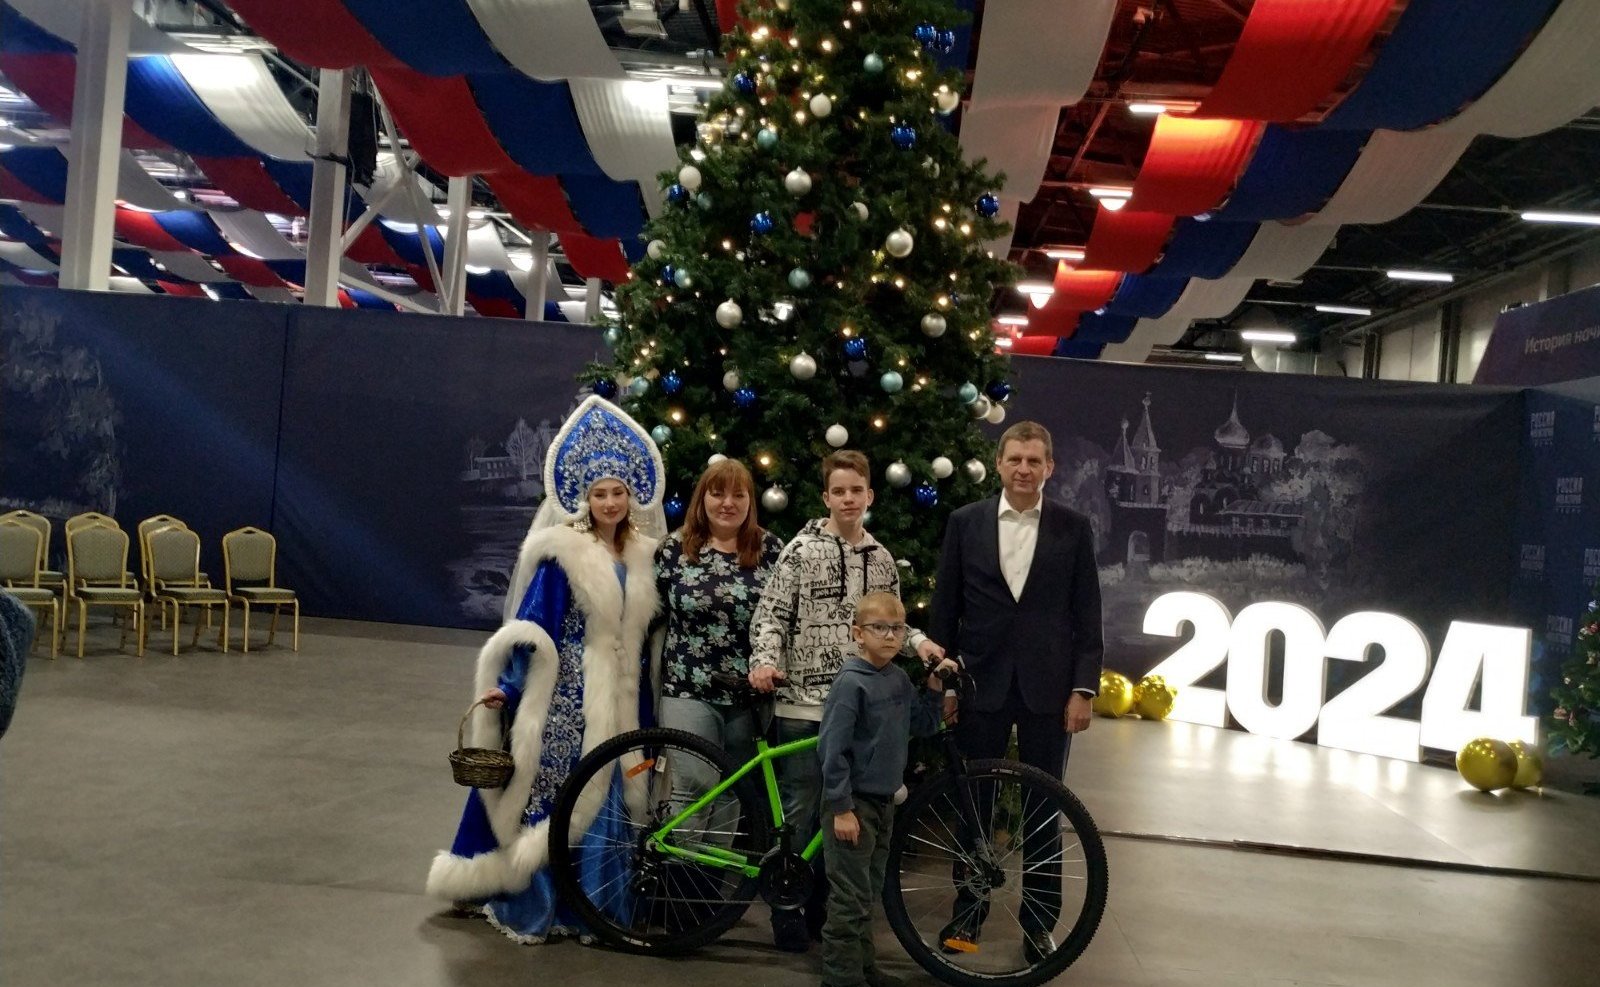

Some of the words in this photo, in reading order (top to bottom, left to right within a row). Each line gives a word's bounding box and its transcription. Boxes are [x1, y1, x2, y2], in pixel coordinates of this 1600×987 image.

[1524, 333, 1573, 355] История
[810, 579, 828, 588] STYLE
[1142, 591, 1539, 763] 2024
